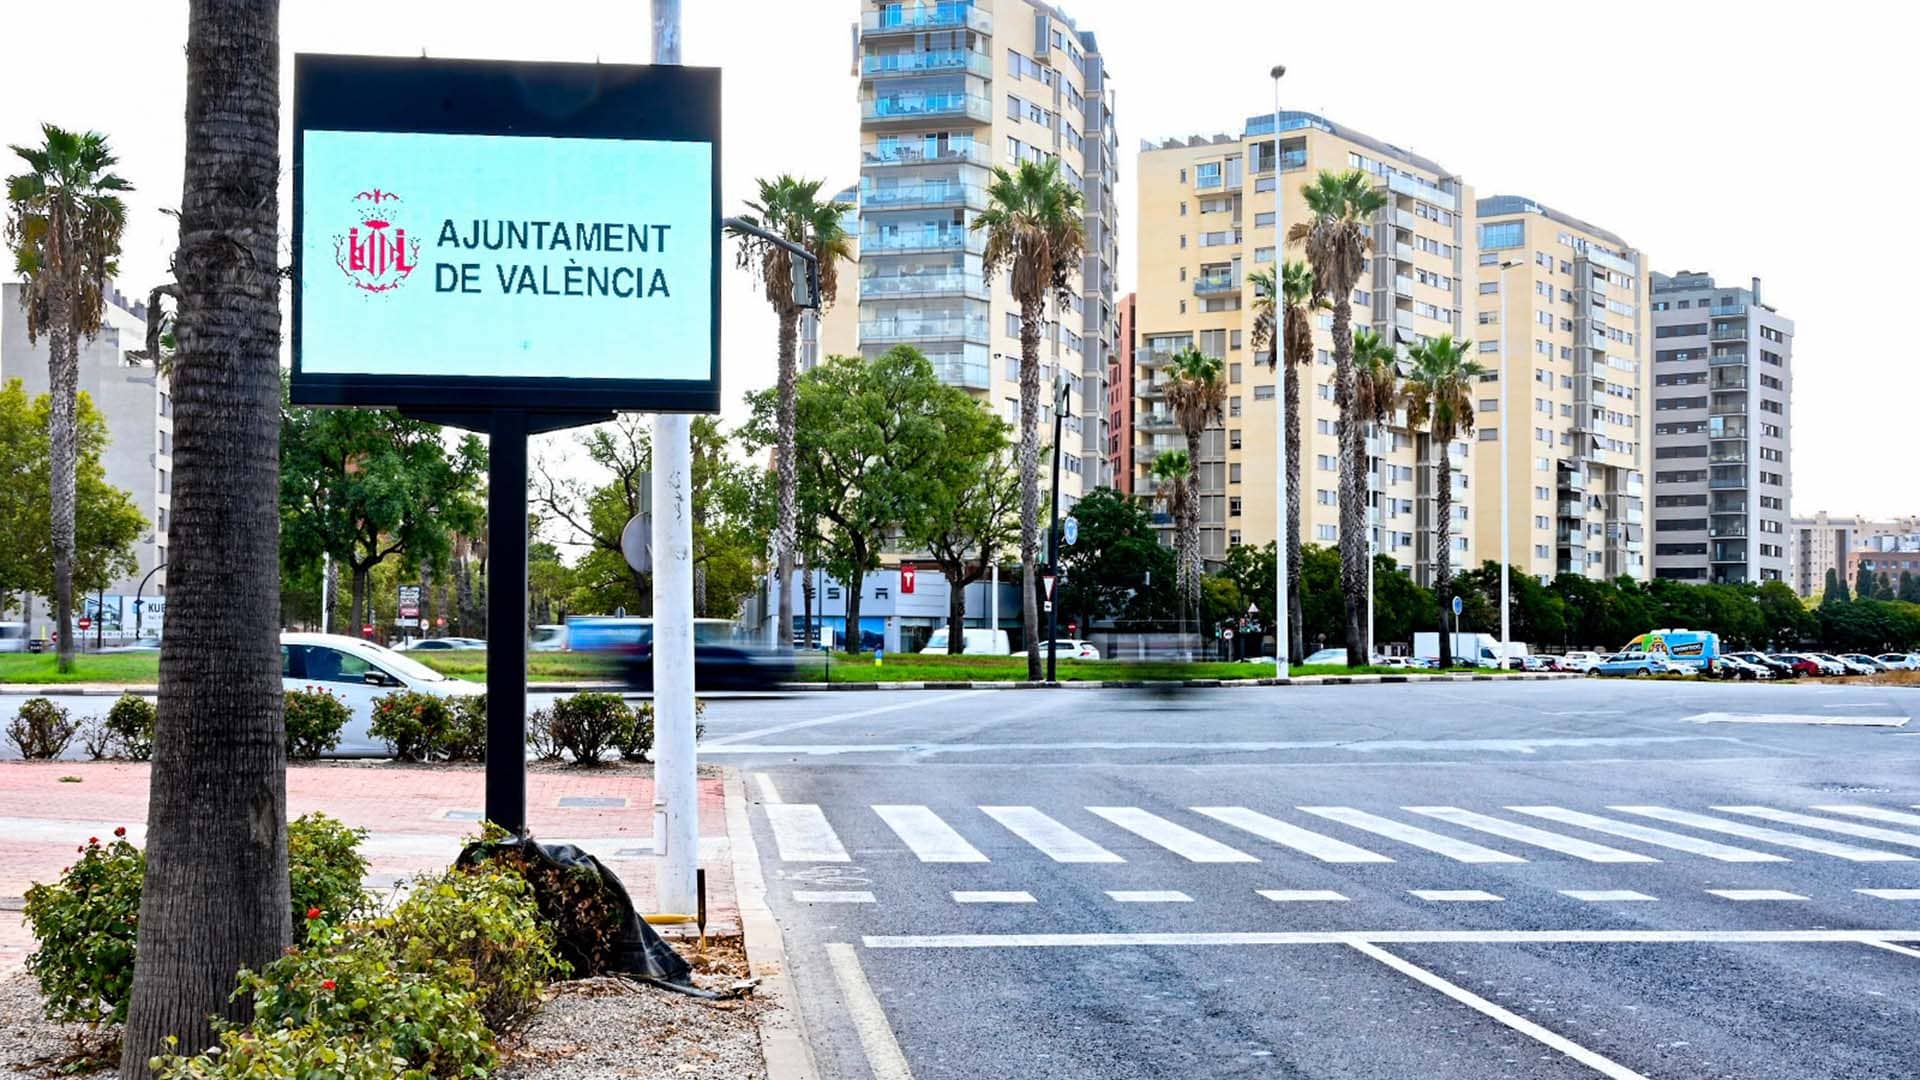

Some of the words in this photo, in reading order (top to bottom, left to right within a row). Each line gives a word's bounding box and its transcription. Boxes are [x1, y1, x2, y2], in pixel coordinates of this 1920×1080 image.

[437, 219, 671, 252] AJUNTAMENT
[436, 263, 481, 293] DE
[496, 259, 670, 298] VALÈNCIA
